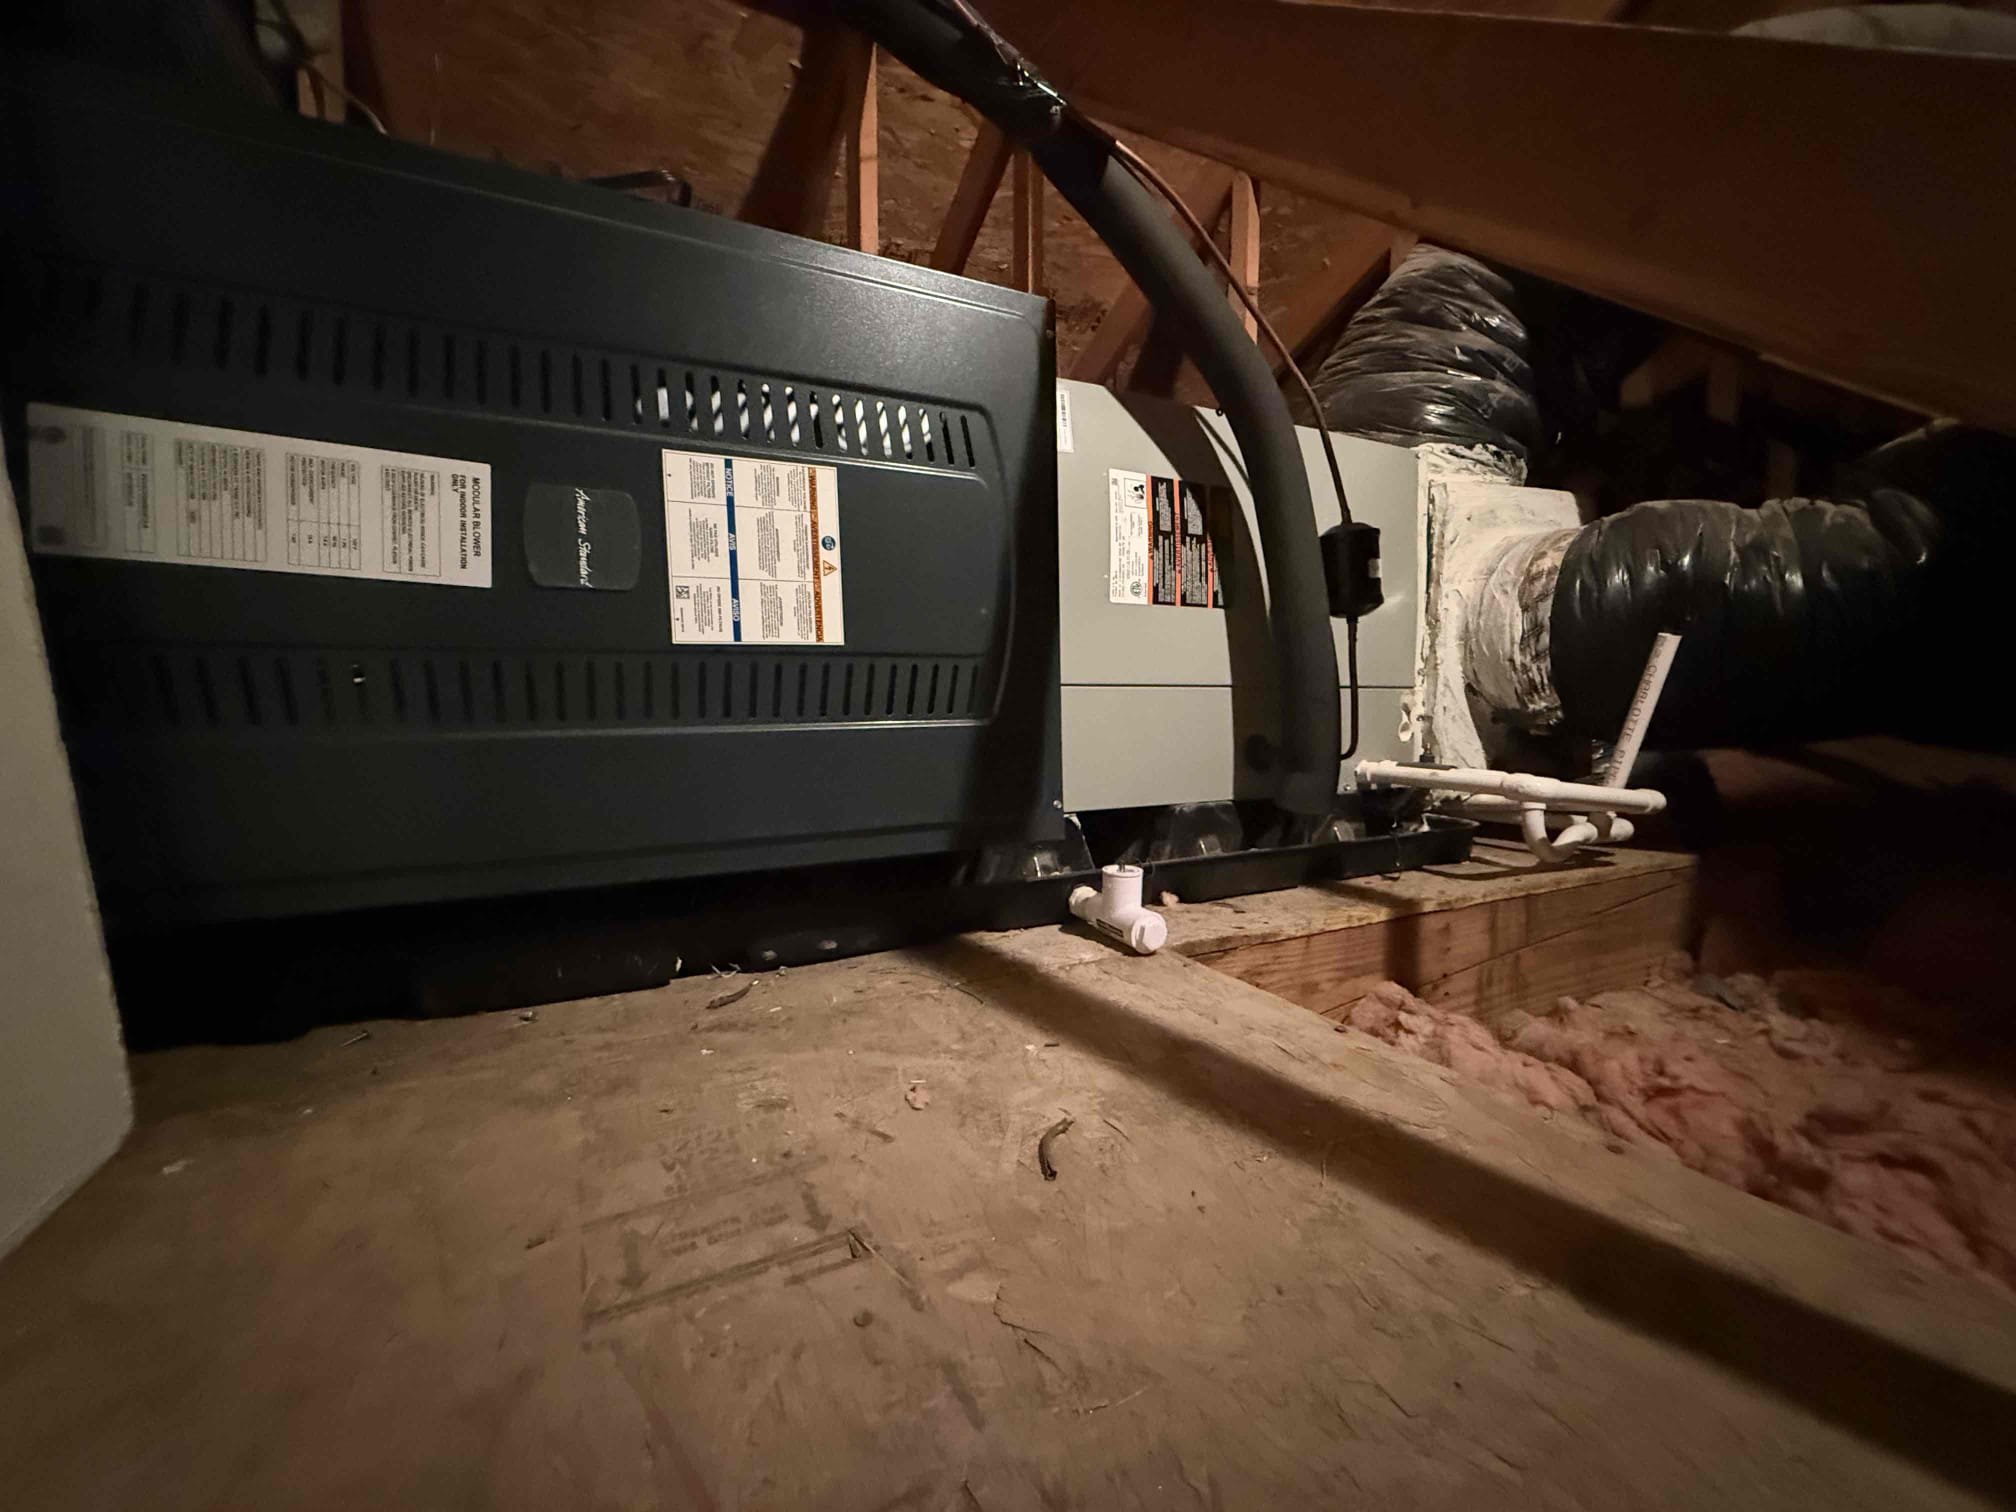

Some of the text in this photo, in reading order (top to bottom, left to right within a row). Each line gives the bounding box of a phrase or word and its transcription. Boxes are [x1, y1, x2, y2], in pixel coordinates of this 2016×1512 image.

[459, 475, 467, 489] FOR
[459, 491, 467, 518] INDOOR
[472, 477, 481, 557] MODULAR BLOWER
[575, 488, 593, 588] American Standard
[725, 467, 740, 622] NOTICE AVIS AVISO
[809, 476, 824, 642] WARNING AVERTISSEMENT ADVERTENCIA
[1622, 664, 1658, 743] CHARLOTTE
